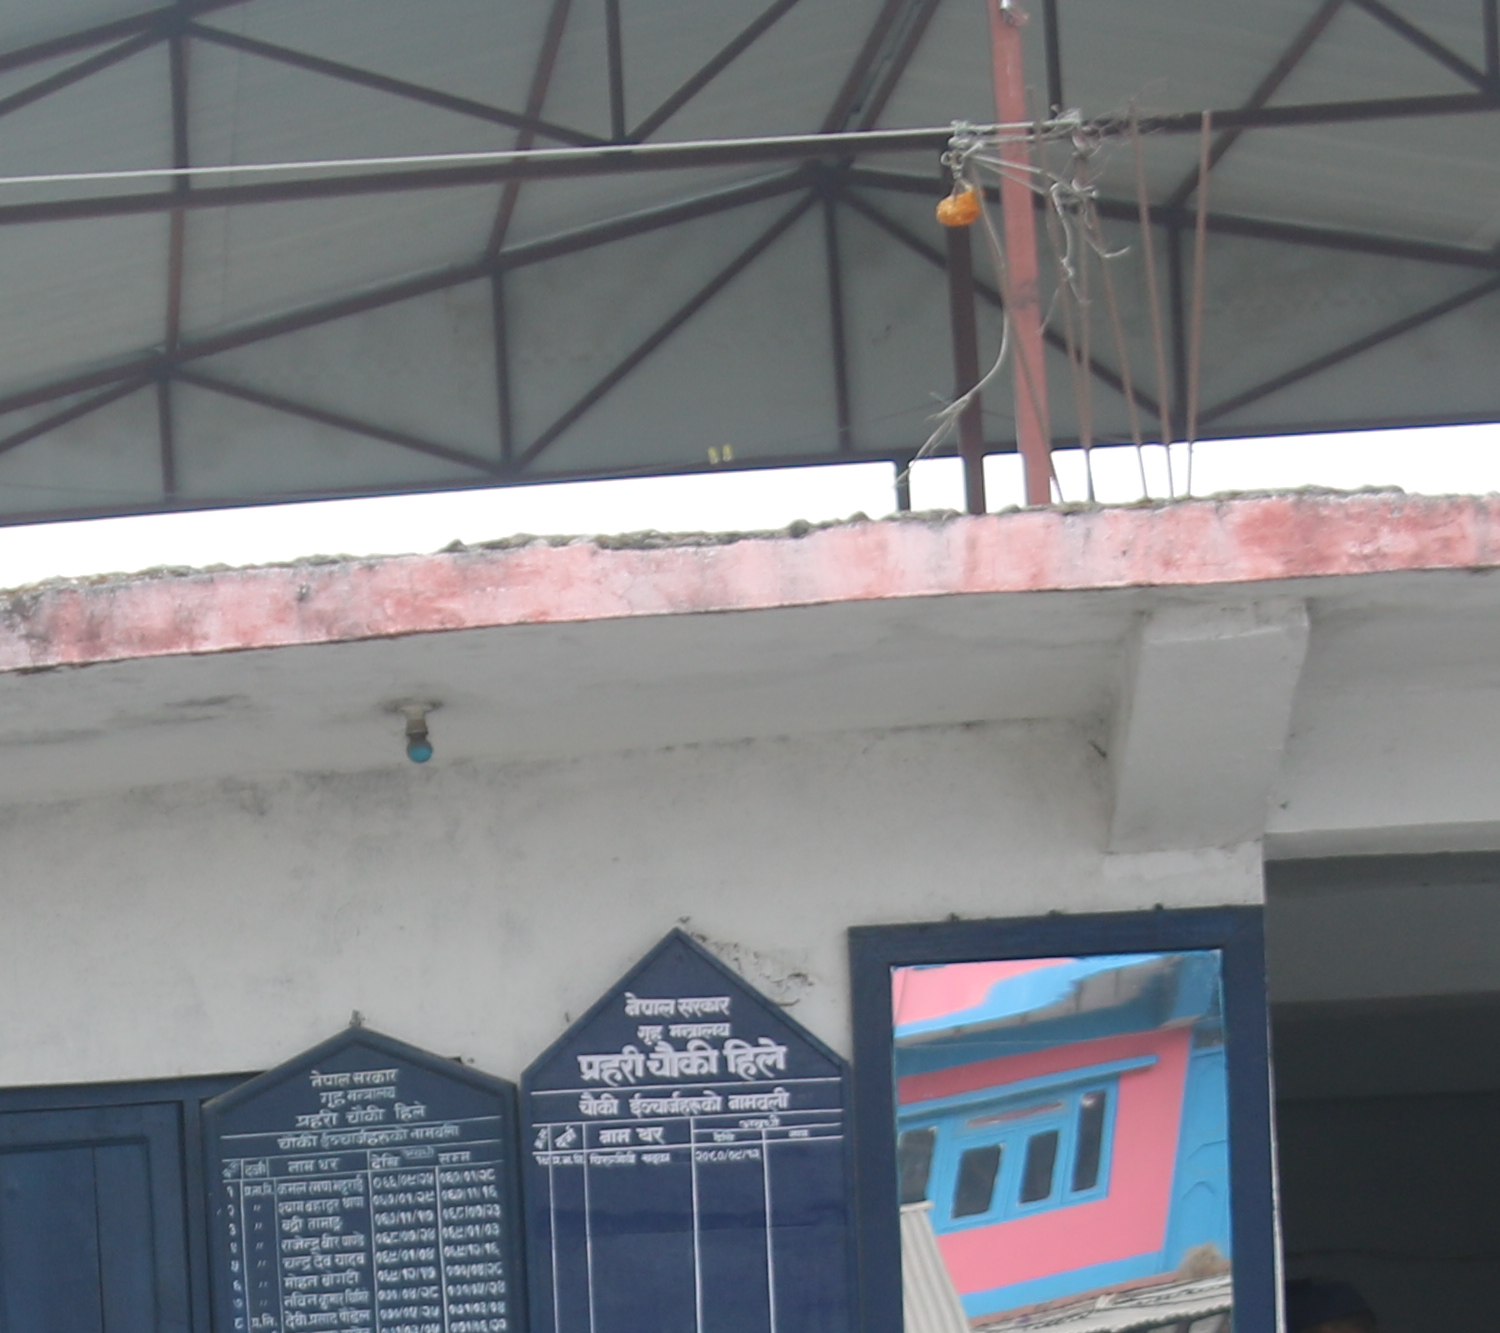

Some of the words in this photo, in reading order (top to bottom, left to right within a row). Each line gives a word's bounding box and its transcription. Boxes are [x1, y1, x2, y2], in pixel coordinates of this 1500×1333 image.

[624, 993, 675, 1017] नेपाल
[677, 997, 730, 1017] सरकार
[638, 1025, 662, 1045] गृह
[669, 1022, 730, 1038] मन्त्रालय
[577, 1045, 644, 1086] प्रहरी
[647, 1040, 719, 1078] चौकी
[723, 1038, 786, 1080] हिले
[310, 1070, 350, 1088] नेपाल
[352, 1069, 398, 1083] सरकार
[296, 1109, 339, 1128] प्रहरी
[346, 1104, 385, 1124] चौकी
[394, 1101, 427, 1119] हिले
[579, 1091, 618, 1116] चौकी
[278, 1132, 318, 1150] चौकी
[599, 1127, 630, 1144] नाम
[288, 1160, 315, 1173] नाम
